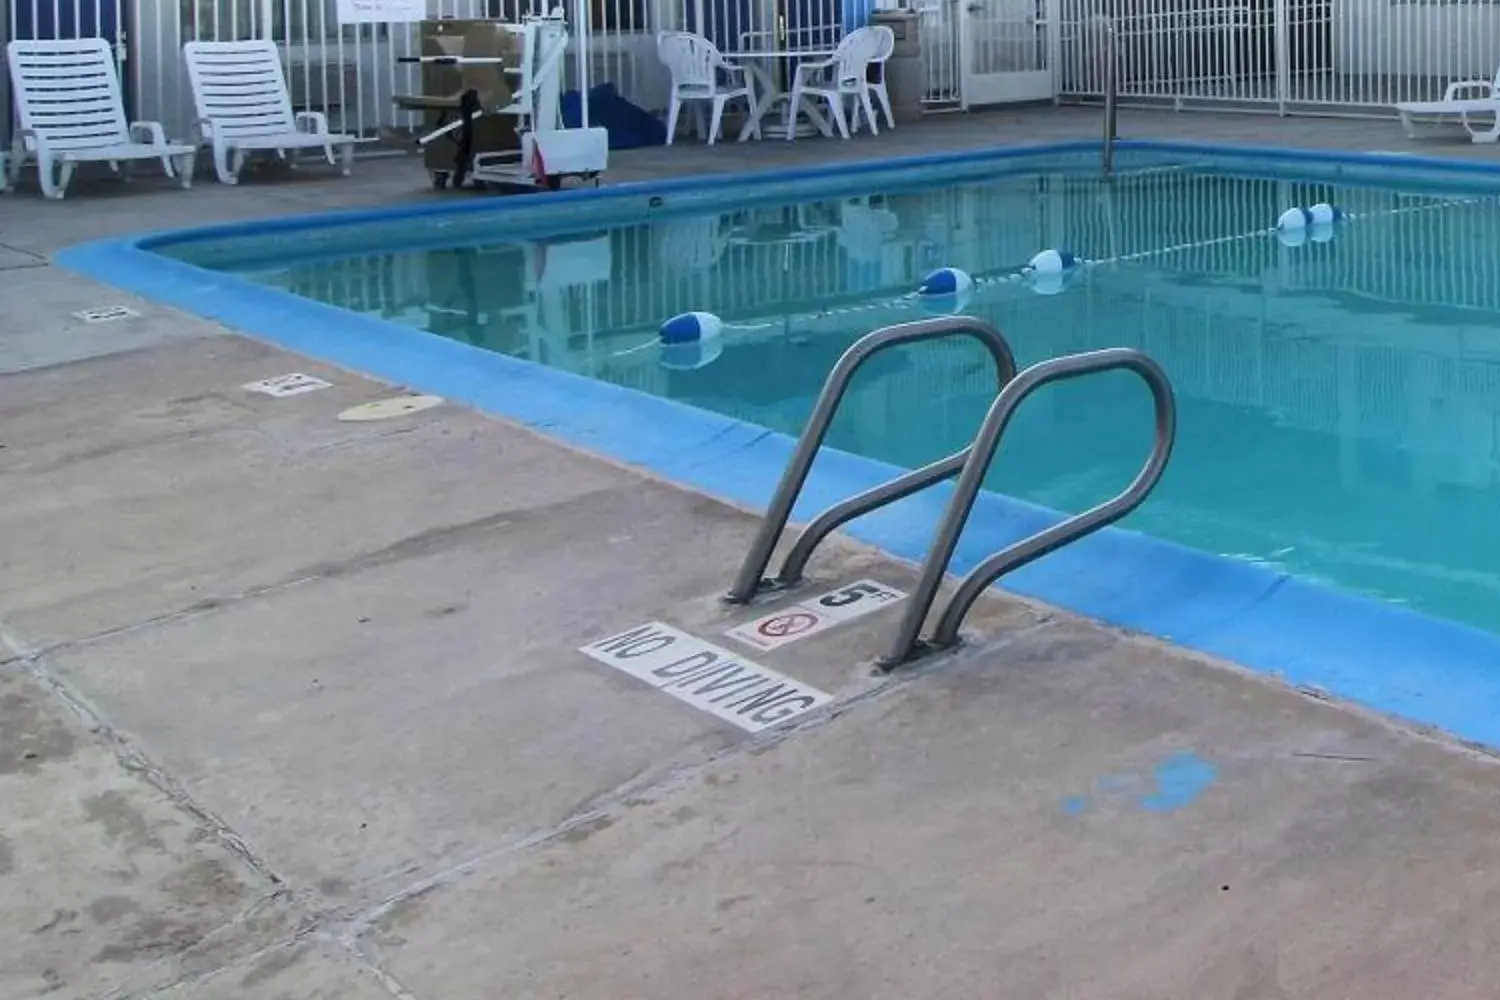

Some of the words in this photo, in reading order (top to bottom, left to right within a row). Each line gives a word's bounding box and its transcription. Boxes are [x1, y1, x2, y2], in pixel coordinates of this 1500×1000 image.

[820, 583, 881, 607] 5
[599, 626, 677, 660] NO
[651, 650, 816, 725] DIVING
